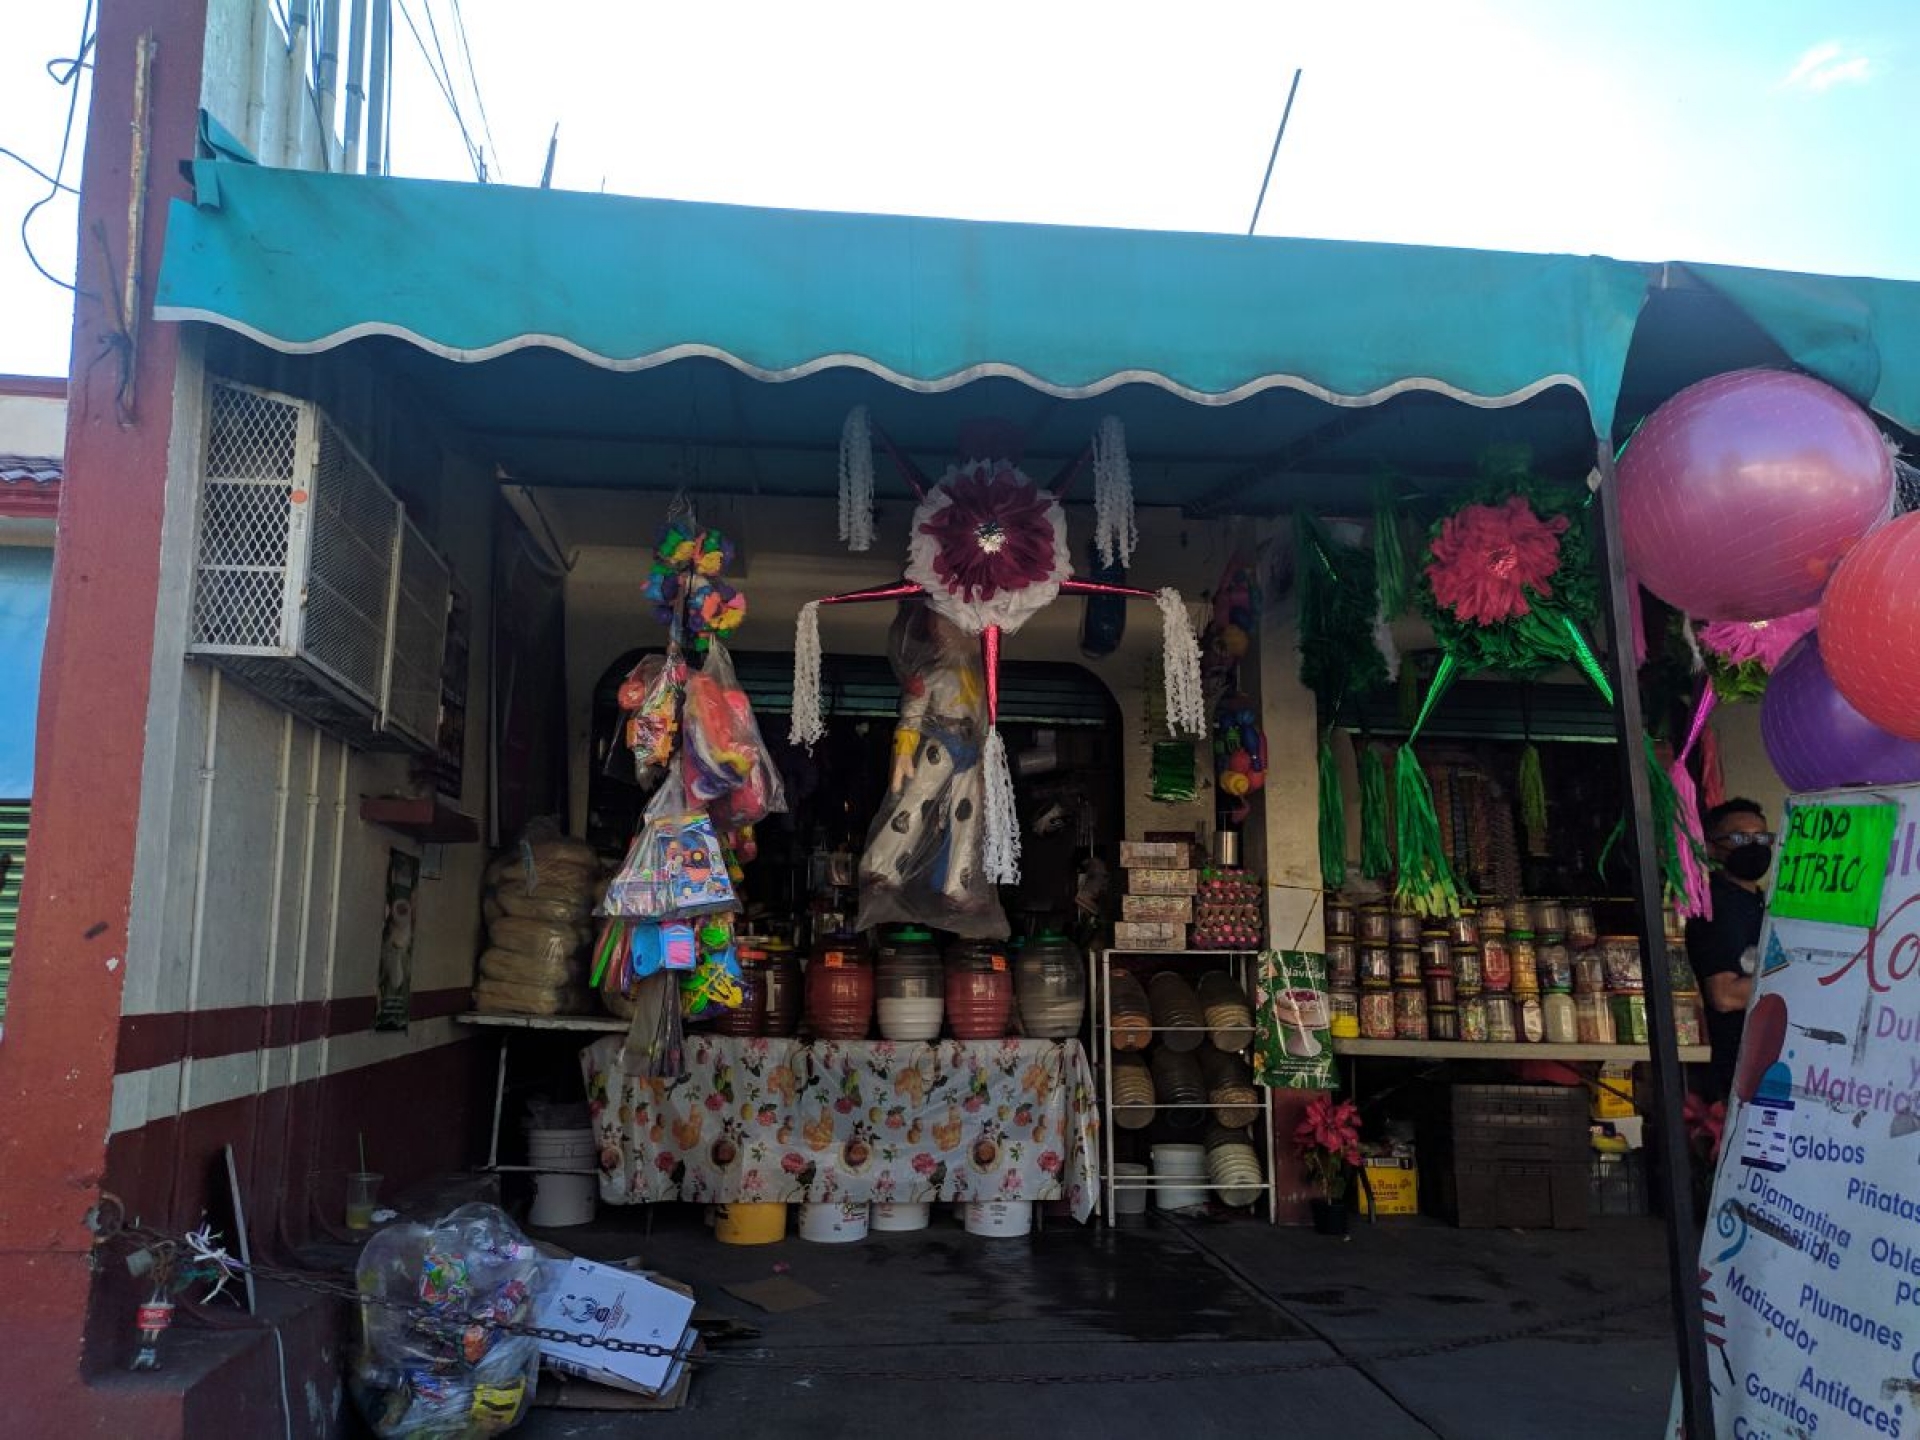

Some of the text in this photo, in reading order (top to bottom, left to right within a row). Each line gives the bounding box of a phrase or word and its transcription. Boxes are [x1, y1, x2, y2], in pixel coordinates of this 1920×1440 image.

[1793, 1136, 1865, 1164] Globos
[1750, 1172, 1851, 1248] Diamantina
[1848, 1177, 1920, 1222] Piñatas
[1726, 1266, 1818, 1356] Matizador
[1799, 1284, 1902, 1351] Plumones
[1746, 1372, 1819, 1432] Gorritos
[1800, 1366, 1902, 1438] Antifaces
